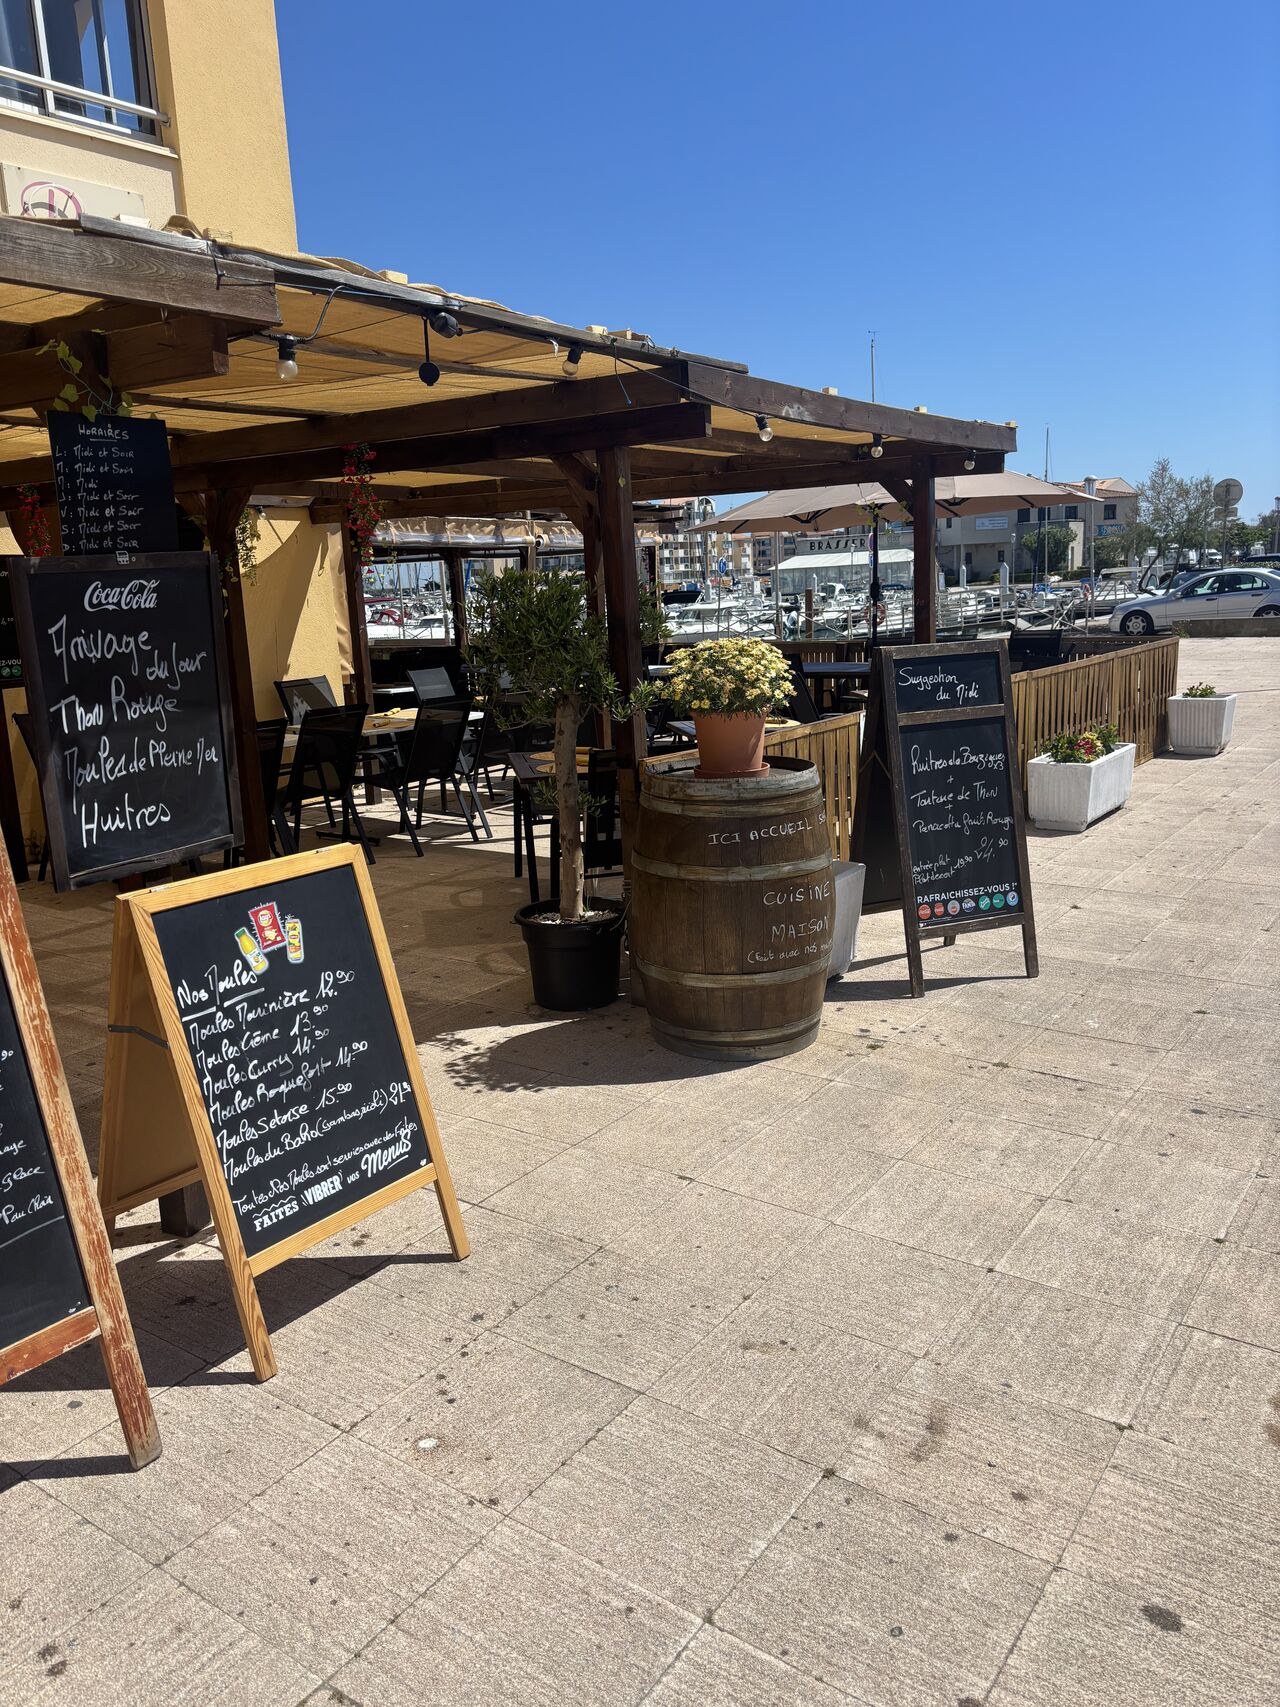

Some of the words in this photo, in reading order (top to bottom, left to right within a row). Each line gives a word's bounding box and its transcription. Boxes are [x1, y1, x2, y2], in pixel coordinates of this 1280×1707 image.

[73, 444, 93, 459] Midi
[98, 447, 108, 457] et
[74, 463, 95, 479] Midi
[100, 462, 111, 473] et
[112, 463, 134, 474] Soir
[76, 478, 98, 493] Midi
[77, 491, 100, 507] Midi
[103, 490, 114, 500] et
[116, 490, 140, 500] Soir
[77, 507, 100, 521] Midi
[105, 505, 115, 516] et
[118, 505, 144, 516] Soir
[78, 522, 100, 538] Midi
[103, 520, 115, 532] et
[117, 520, 141, 530] Soir
[79, 539, 99, 554] Midi
[103, 537, 113, 548] et
[810, 538, 866, 551] BRASSER
[84, 579, 160, 612] Coca-Cola
[146, 649, 169, 681] du
[167, 642, 207, 690] Jour
[898, 666, 959, 691] Suggestion
[50, 695, 104, 734] Thon
[111, 675, 184, 732] Rouge
[936, 686, 951, 701] du
[956, 682, 979, 705] Midi
[129, 737, 147, 773] de
[149, 739, 193, 768] Pleine
[957, 786, 971, 801] de
[82, 793, 171, 849] Huitres
[708, 832, 741, 845] ICI
[749, 817, 813, 841] ACCUEIL
[917, 883, 1010, 904] RAFRAICHISSEZ-VOUS
[771, 915, 830, 942] MAISON
[779, 949, 800, 959] avec
[804, 942, 818, 954] nos
[177, 979, 209, 1009] Nos
[204, 959, 258, 1005] Moules
[189, 1011, 235, 1050] Moules
[196, 1039, 241, 1073] Moules
[203, 1063, 248, 1106] Moules
[248, 1053, 294, 1080] Curry
[210, 1090, 255, 1126] Moules
[216, 1118, 259, 1163] Moules
[363, 1138, 383, 1150] avec
[224, 1147, 264, 1186] Moules
[264, 1142, 285, 1160] du
[254, 1199, 300, 1232] FAITES
[304, 1175, 342, 1205] VIBRER
[347, 1170, 360, 1184] vos
[360, 1130, 412, 1178] Menus
